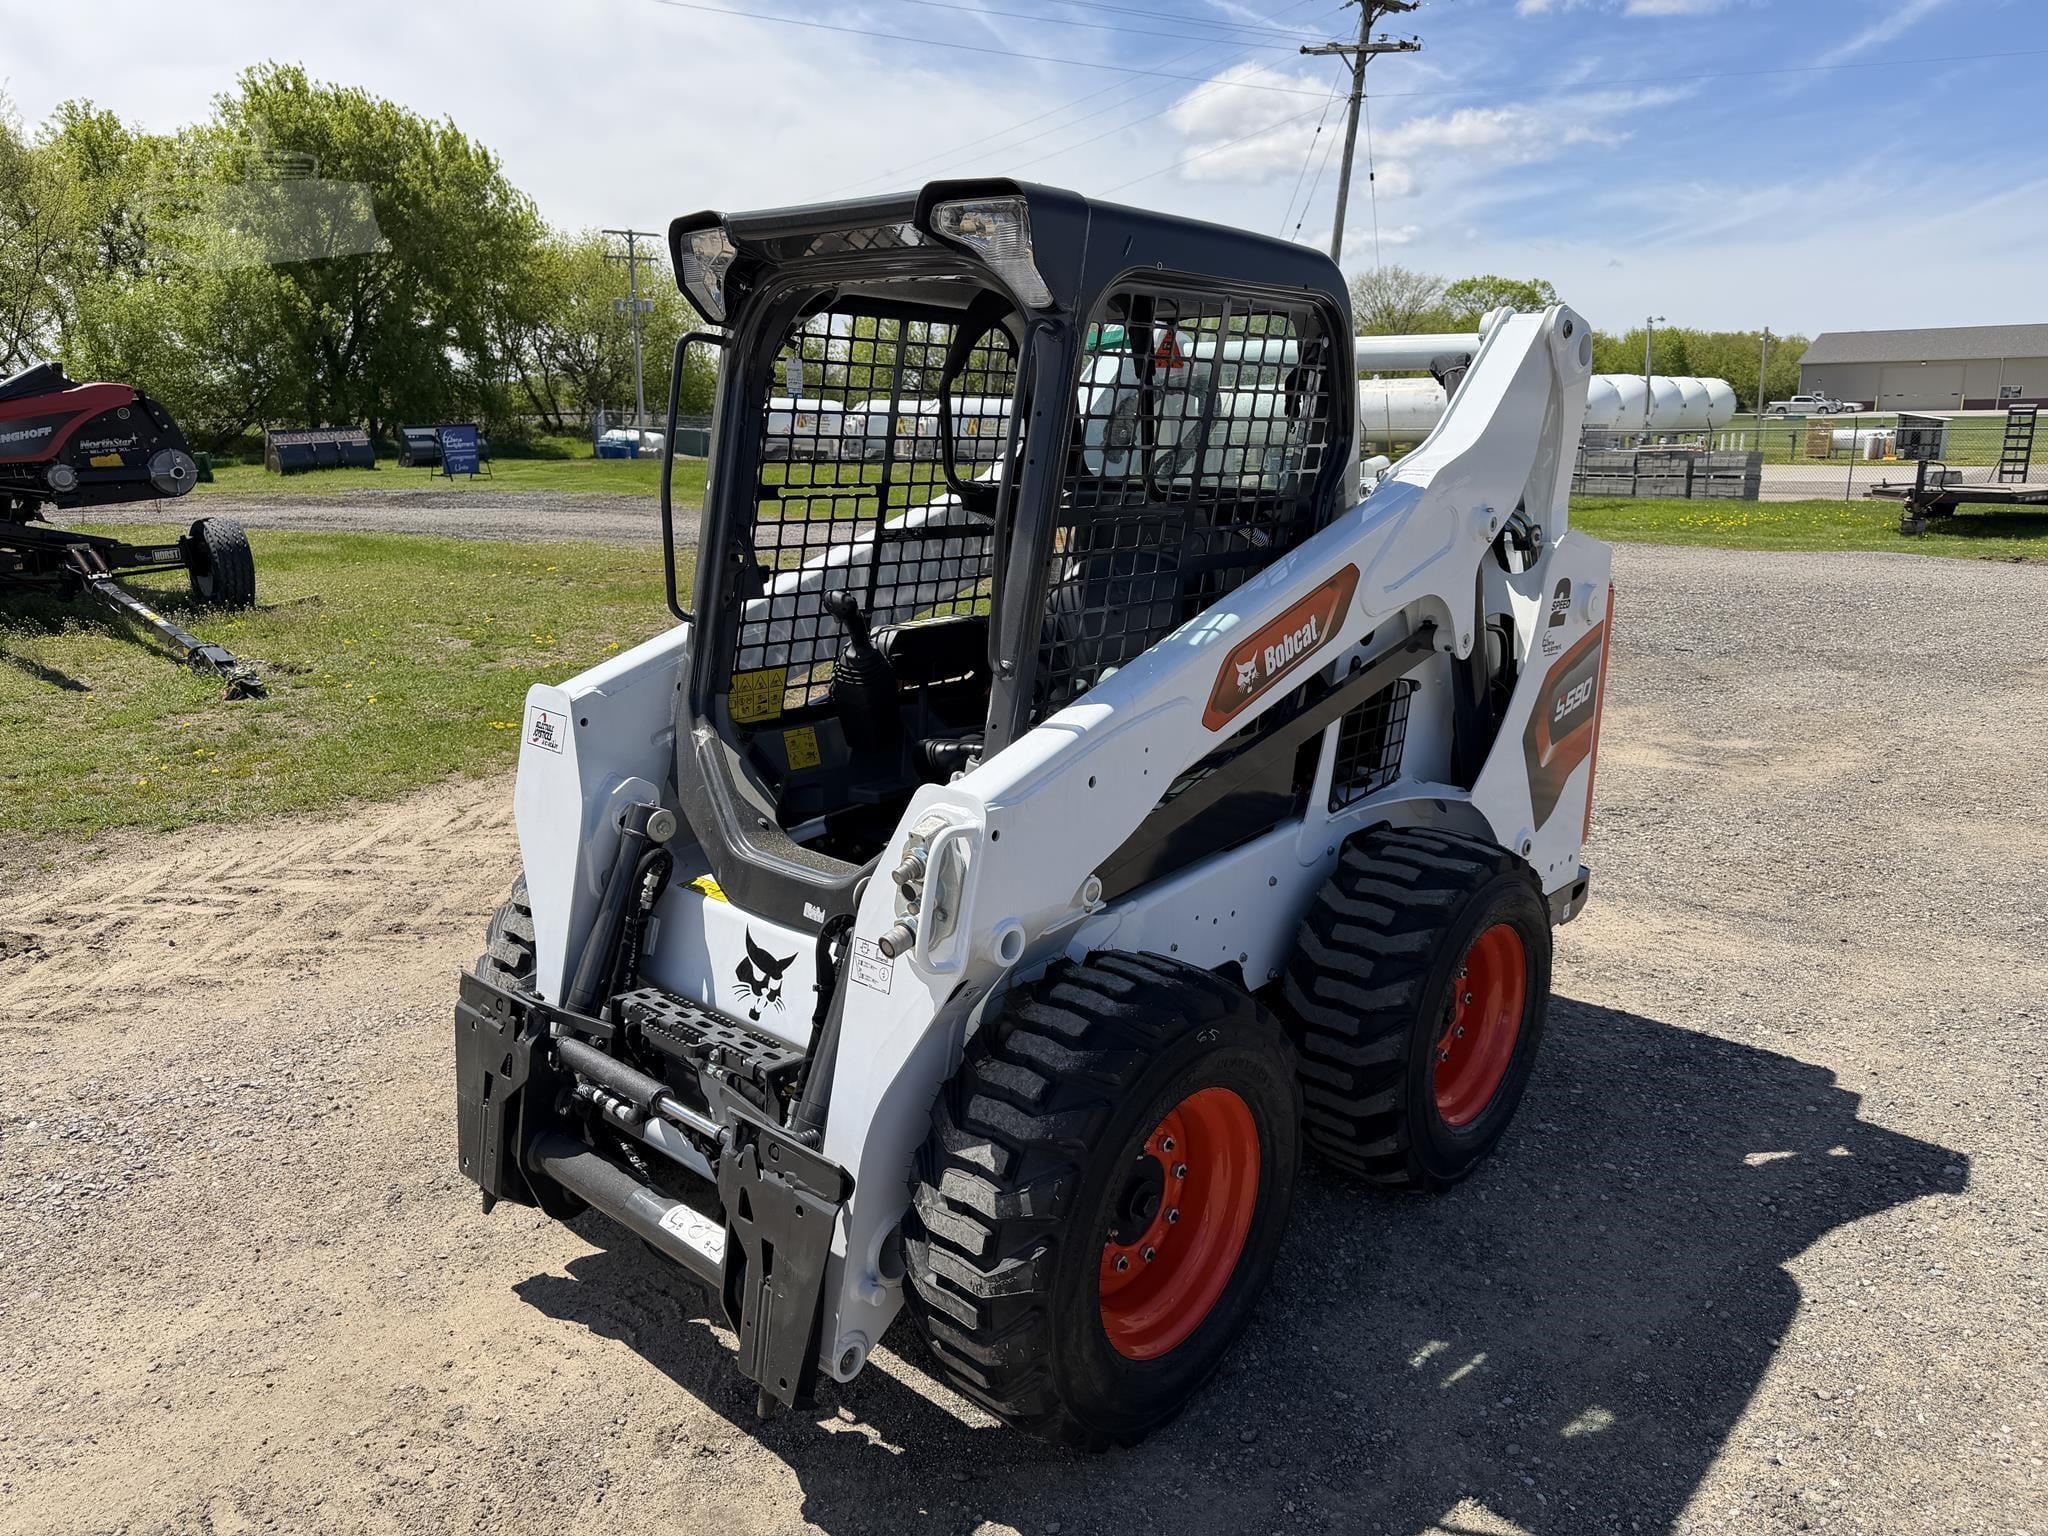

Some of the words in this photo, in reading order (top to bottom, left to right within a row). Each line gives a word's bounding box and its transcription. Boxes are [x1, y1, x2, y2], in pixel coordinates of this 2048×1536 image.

[1551, 599, 1571, 612] SPEED
[1263, 614, 1319, 677] Bobcat
[1554, 676, 1593, 722] S590
